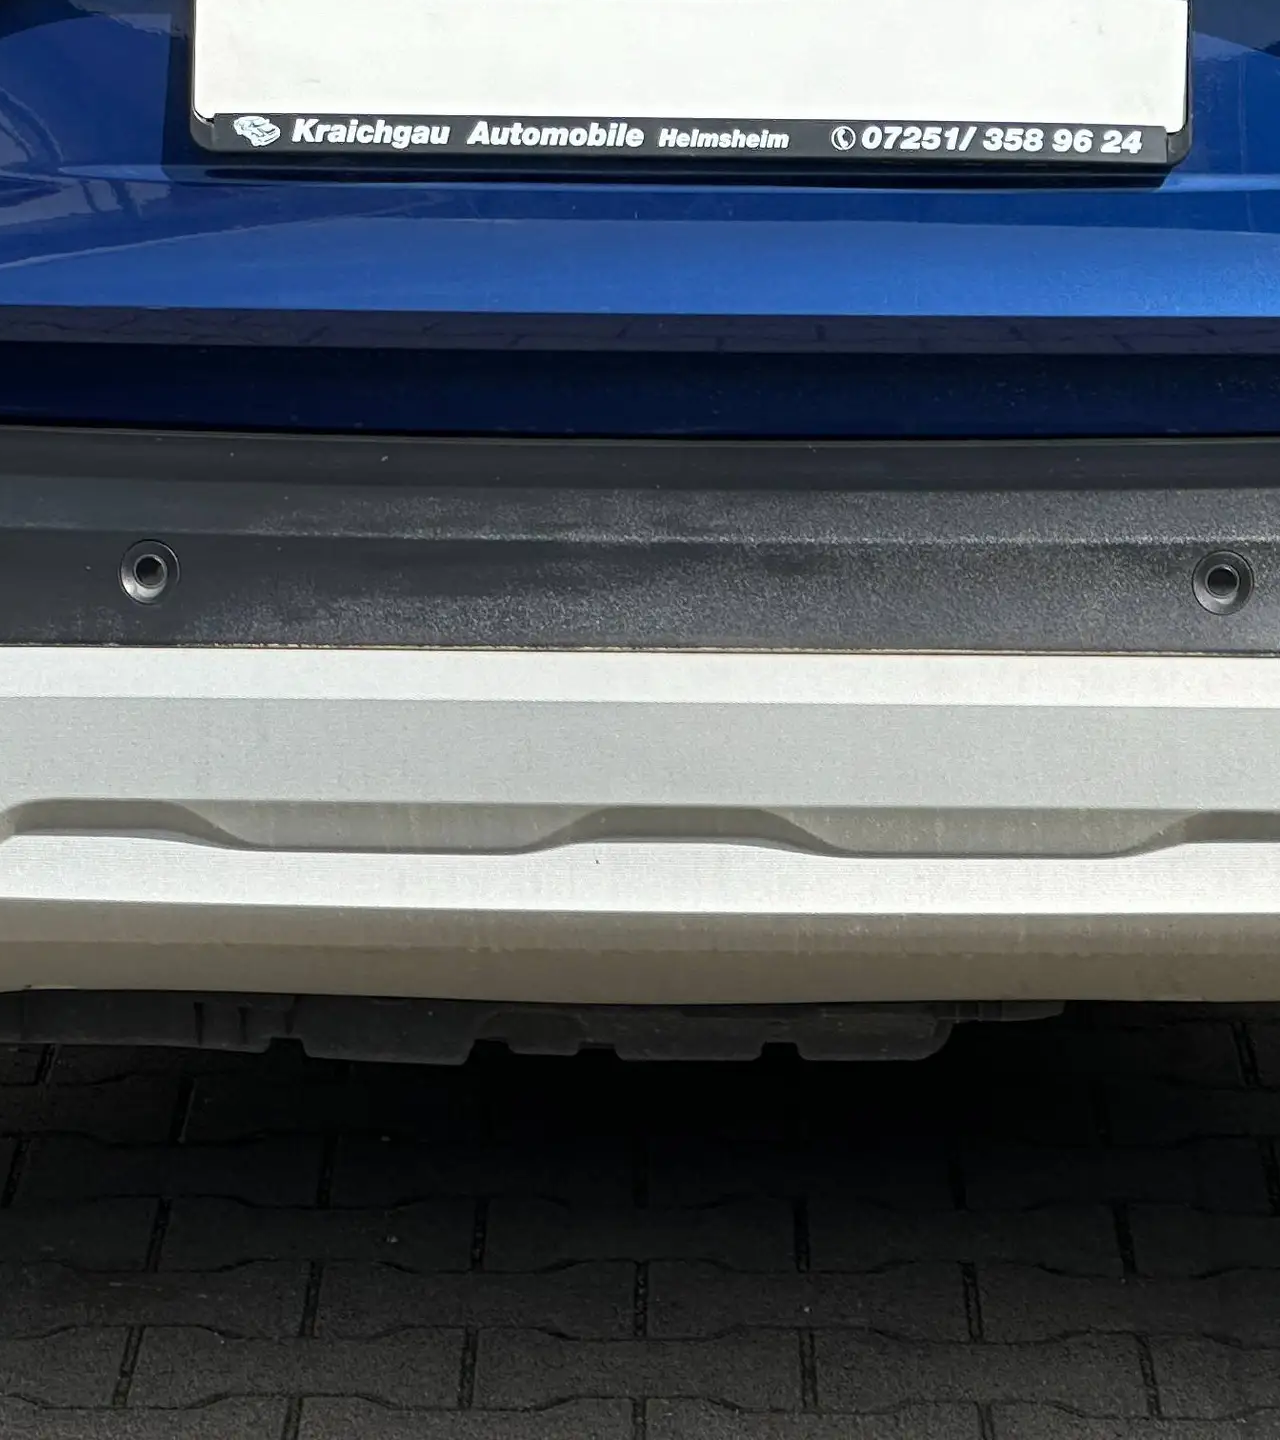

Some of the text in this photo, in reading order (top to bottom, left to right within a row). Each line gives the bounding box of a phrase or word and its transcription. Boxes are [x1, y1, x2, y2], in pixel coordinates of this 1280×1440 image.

[292, 119, 1143, 154] Kraichgau Automobile Helmsheim 07251/ 358 96 24
